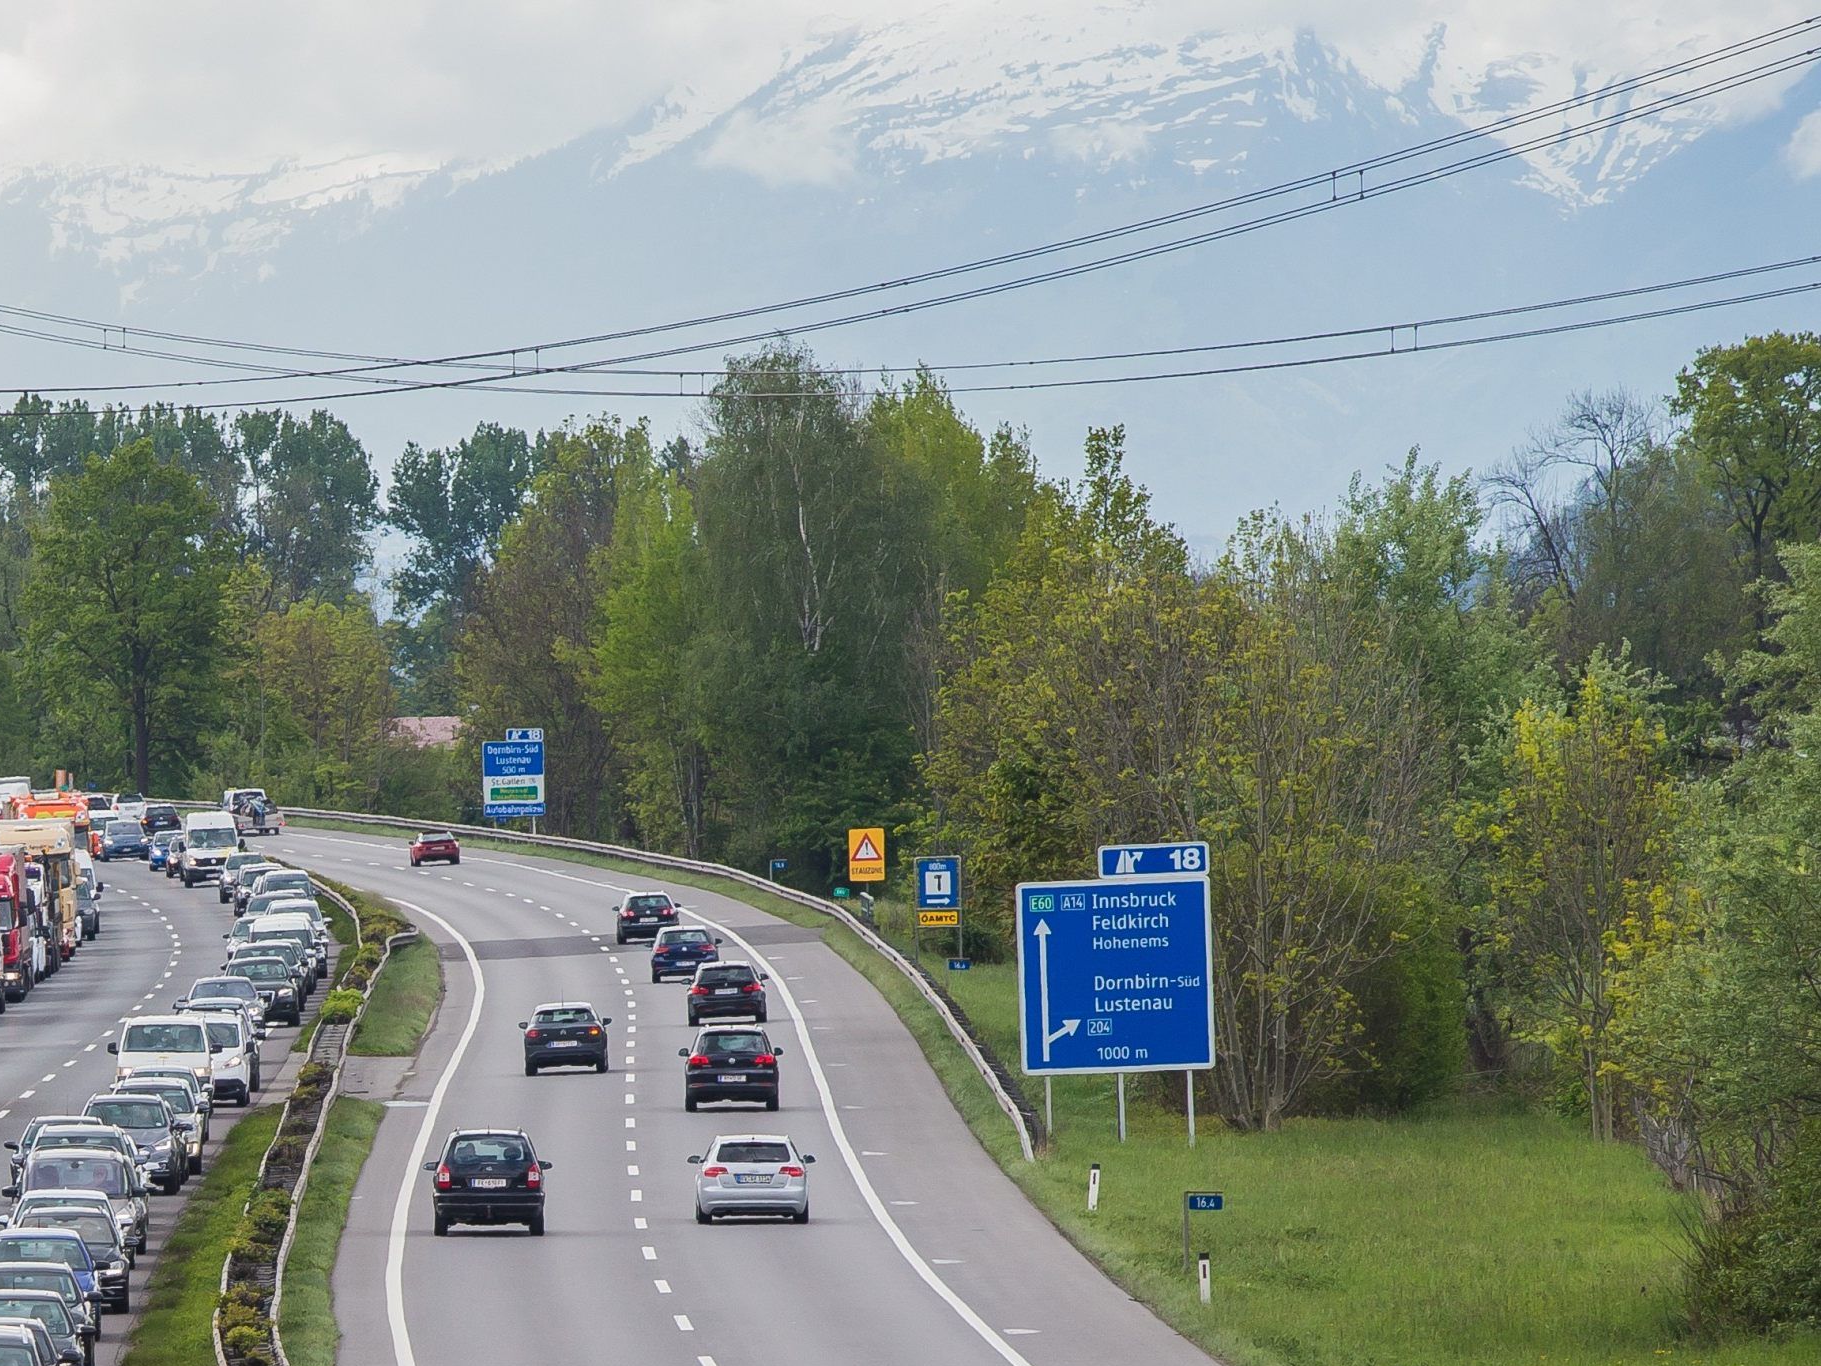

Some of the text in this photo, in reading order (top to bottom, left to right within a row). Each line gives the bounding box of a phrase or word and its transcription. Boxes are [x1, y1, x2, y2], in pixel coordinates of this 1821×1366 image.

[528, 730, 541, 740] 18
[487, 745, 539, 754] Dornbirn-Süd
[496, 757, 532, 765] Lustenau
[502, 766, 516, 774] 500
[486, 805, 544, 815] Autobahnpolizei
[1169, 848, 1201, 870] 18
[1031, 891, 1177, 910] E60 A14 Innsbruck
[1092, 913, 1169, 931] Feldkirch
[1093, 936, 1169, 950] Hohenems
[1094, 973, 1200, 991] Dornbirn-Süd
[1095, 997, 1173, 1012] Lustenau
[1089, 1021, 1110, 1034] 204
[1097, 1047, 1149, 1060] 1000 m
[1196, 1196, 1215, 1208] 16.4
